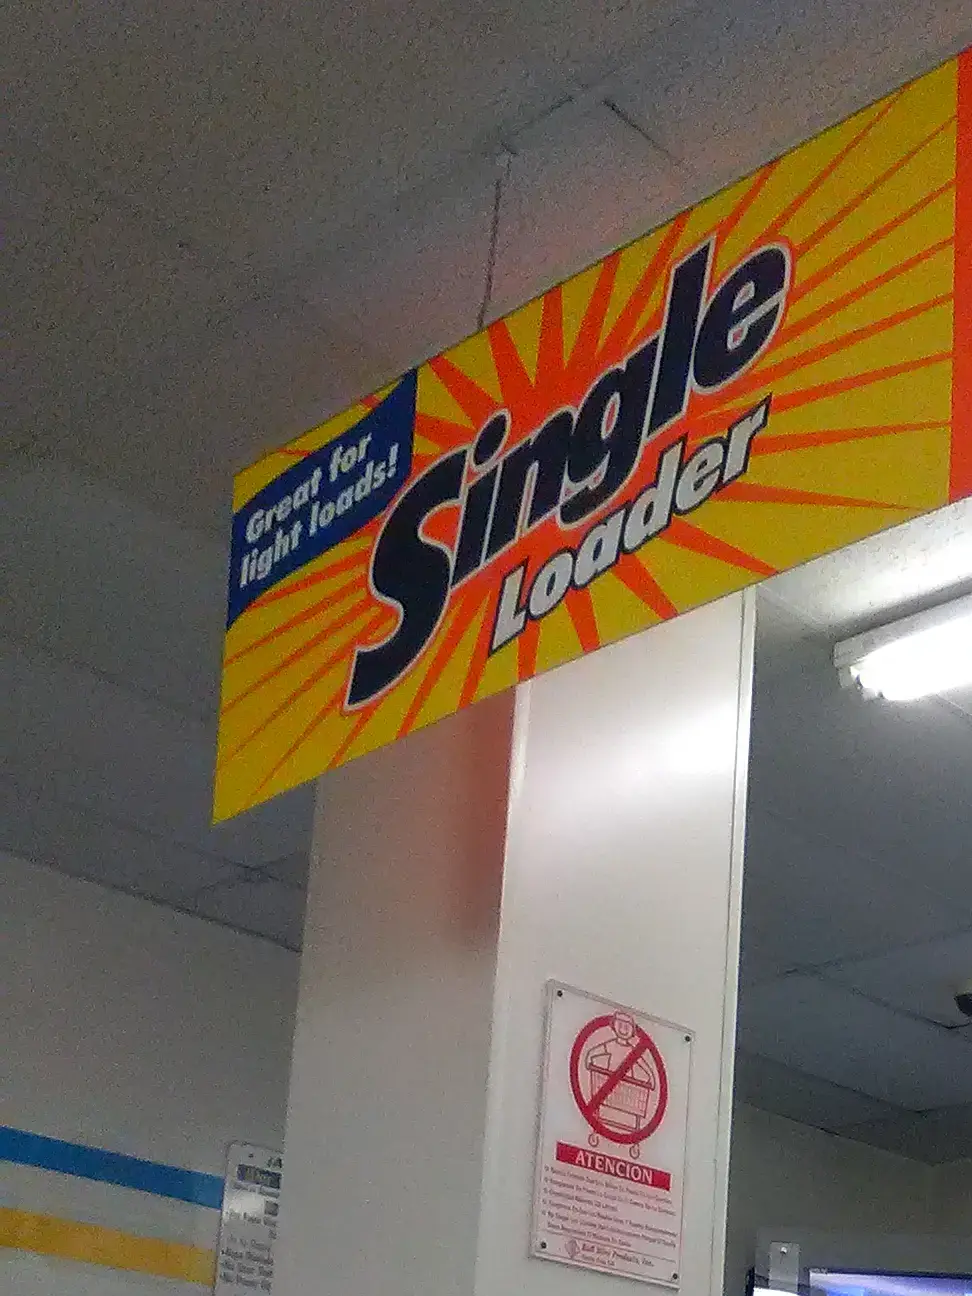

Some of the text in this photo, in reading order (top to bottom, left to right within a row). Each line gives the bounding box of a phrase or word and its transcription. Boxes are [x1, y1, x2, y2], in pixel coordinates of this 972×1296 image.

[240, 442, 399, 588] light loads!
[246, 432, 372, 543] Great for
[344, 235, 789, 709] Single
[490, 396, 771, 654] Loader
[575, 1150, 653, 1184] ATENCION
